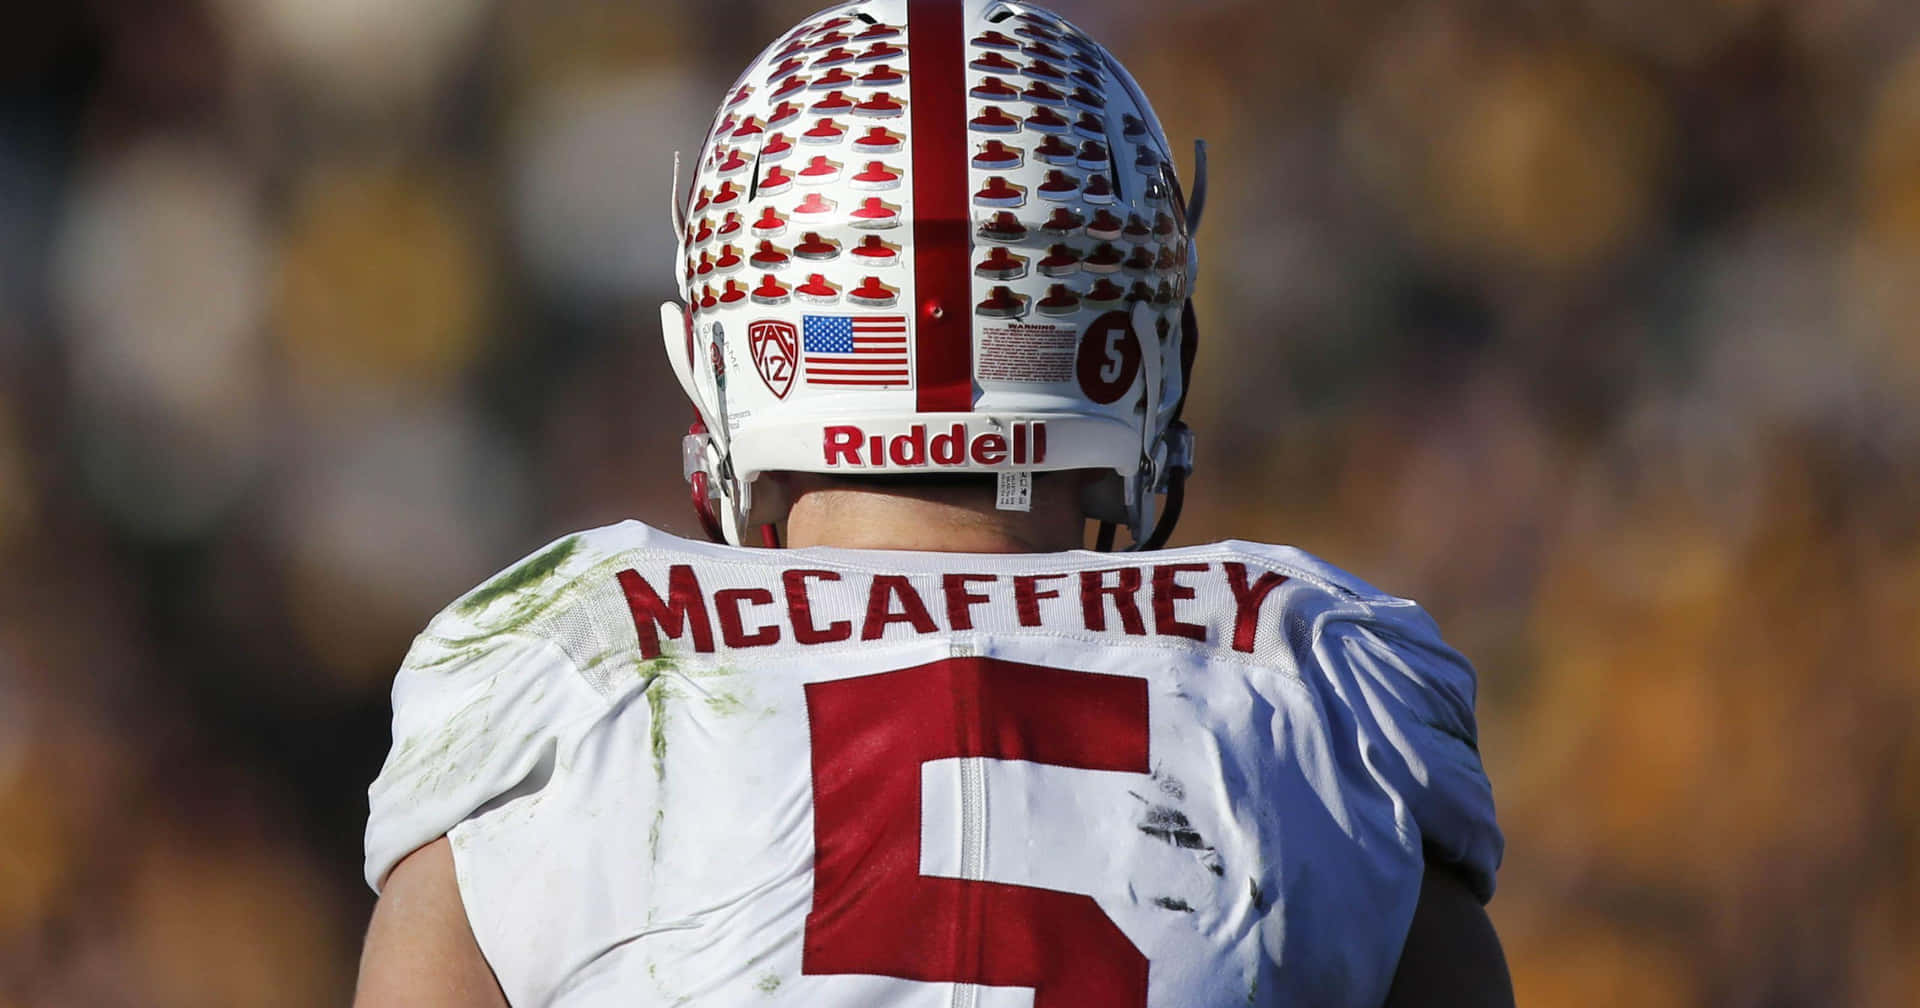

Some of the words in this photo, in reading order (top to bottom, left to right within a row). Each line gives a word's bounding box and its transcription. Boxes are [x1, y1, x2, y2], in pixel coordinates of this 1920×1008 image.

[752, 325, 794, 367] PAC
[765, 356, 788, 381] 12
[1100, 329, 1126, 383] 5
[823, 423, 1047, 467] Riddell
[616, 562, 1287, 660] McCAFFREY
[803, 656, 1150, 1008] 5
